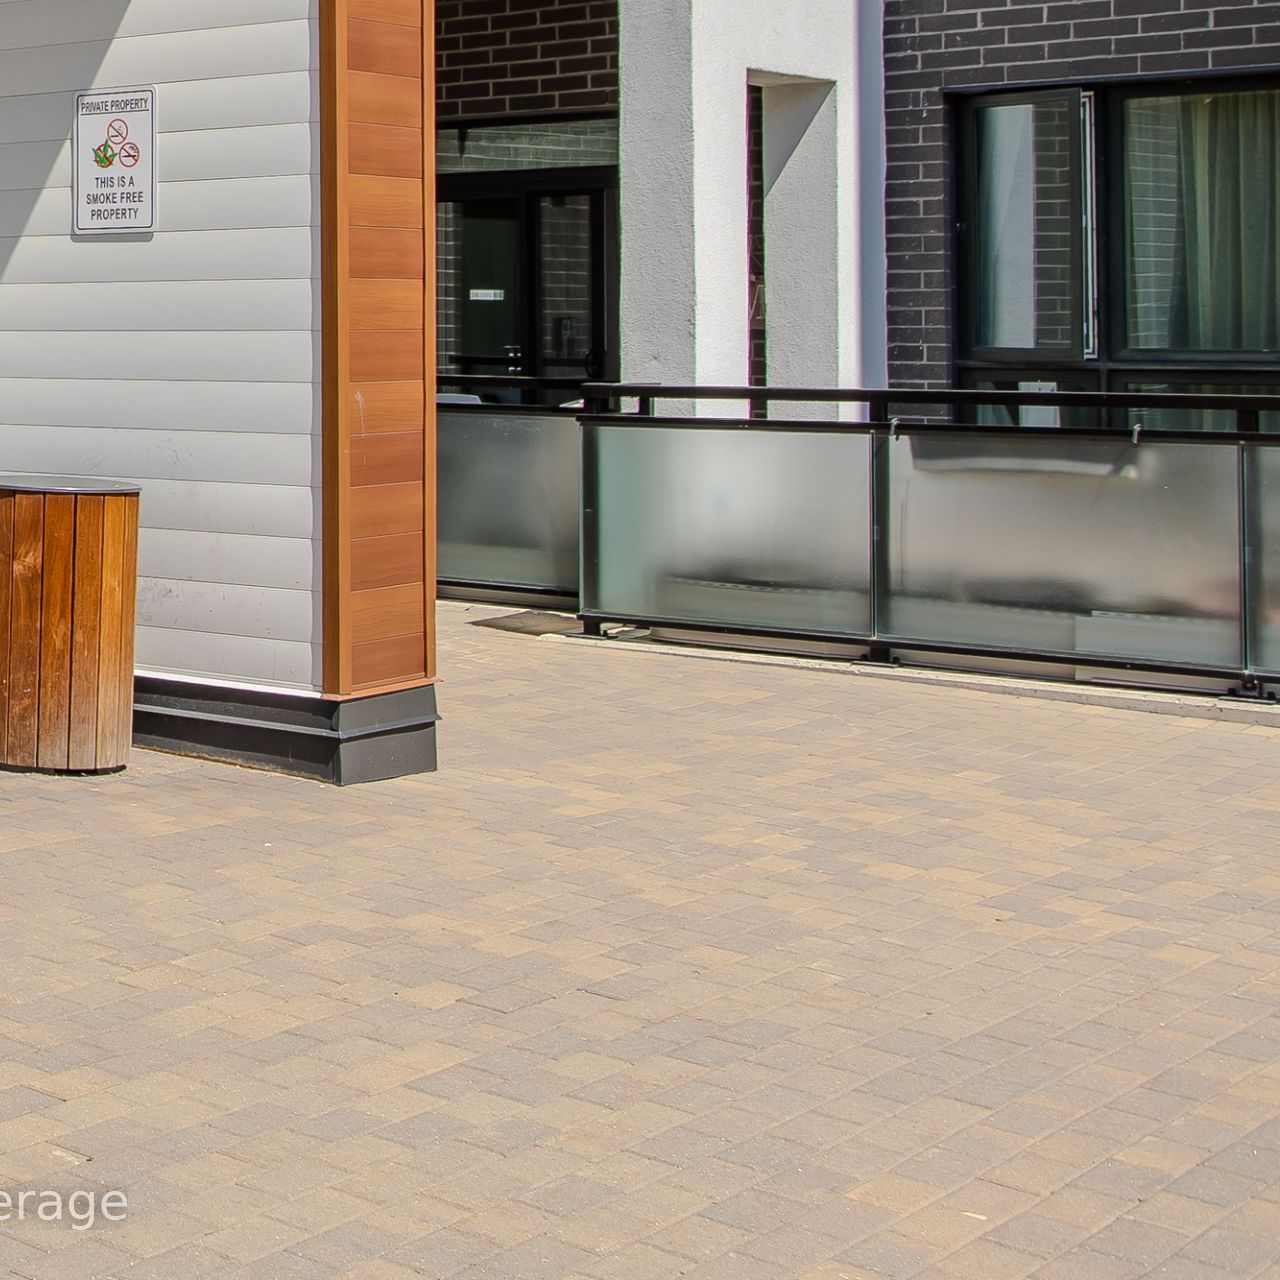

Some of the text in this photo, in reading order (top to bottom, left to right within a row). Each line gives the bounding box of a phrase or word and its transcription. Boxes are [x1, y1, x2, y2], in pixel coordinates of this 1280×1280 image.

[81, 97, 149, 113] PRIVATE PROPERTY
[95, 175, 135, 189] THIS IS A
[86, 191, 144, 205] SMOKE FREE
[91, 207, 139, 220] PROPERTY
